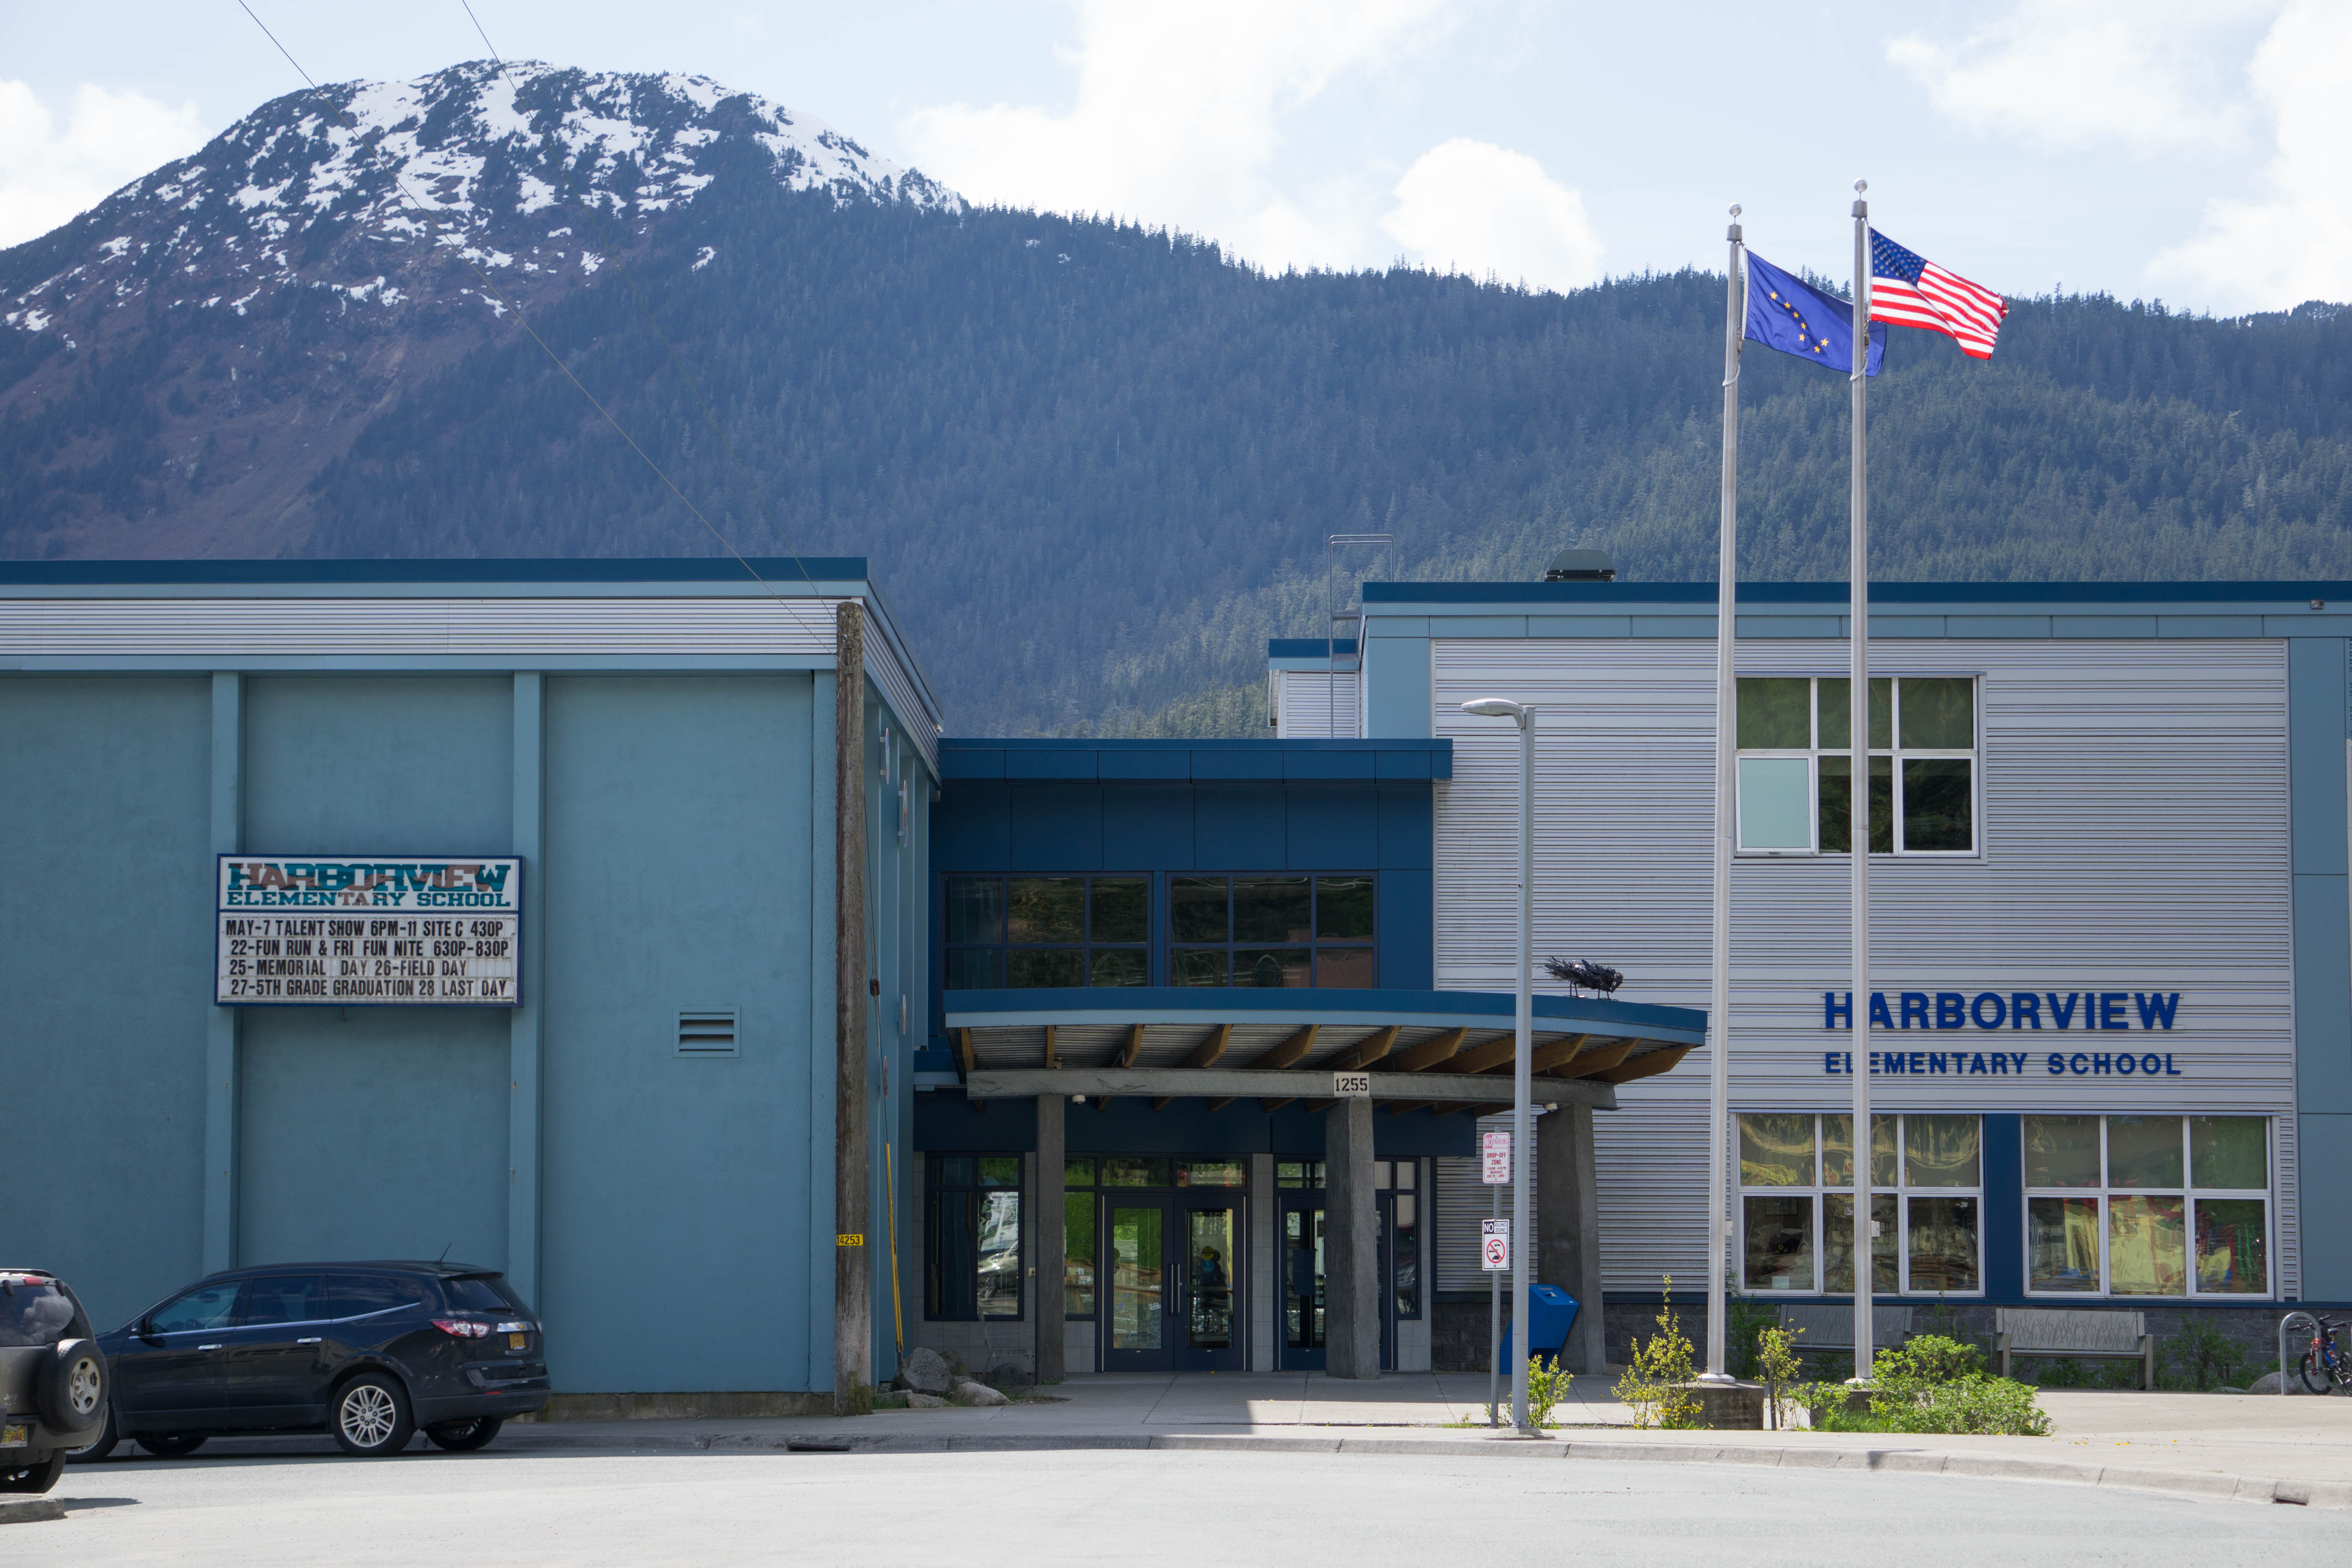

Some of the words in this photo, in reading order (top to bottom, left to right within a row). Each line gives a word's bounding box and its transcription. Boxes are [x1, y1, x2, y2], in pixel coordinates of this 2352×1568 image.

[227, 863, 511, 892] HARBORVIEW
[227, 892, 406, 906] ELEMENTARY
[417, 893, 511, 907] SCHOOL
[226, 920, 271, 936] MAY-7
[276, 920, 325, 936] TALENT
[328, 920, 365, 937] SHOW
[371, 920, 417, 937] 6PM-11
[423, 920, 451, 937] SITE
[455, 921, 464, 937] C
[470, 921, 503, 937] 430P
[231, 939, 280, 956] 22-FUN
[286, 940, 312, 956] RUN
[318, 940, 327, 956] &
[334, 940, 354, 956] FRI
[364, 940, 387, 956] FUN
[394, 940, 423, 956] NITE
[434, 940, 509, 957] 630P-830P
[230, 959, 326, 976] 25-MEMORIAL
[341, 959, 368, 976] DAY
[375, 959, 435, 976] 26-FIELD
[442, 960, 467, 976] DAY
[231, 979, 281, 995] 27-5TH
[286, 979, 327, 996] GRADE
[333, 979, 414, 996] GRADUATION
[419, 980, 435, 996] 28
[442, 980, 474, 996] LAST
[481, 980, 507, 996] DAY
[1825, 992, 2180, 1030] HARBORVIEW
[2048, 1053, 2181, 1075] SCHOOL
[1336, 1078, 1368, 1091] 1255
[1485, 1137, 1492, 1147] NO
[1484, 1223, 1494, 1232] NO
[837, 1235, 860, 1245] 14253
